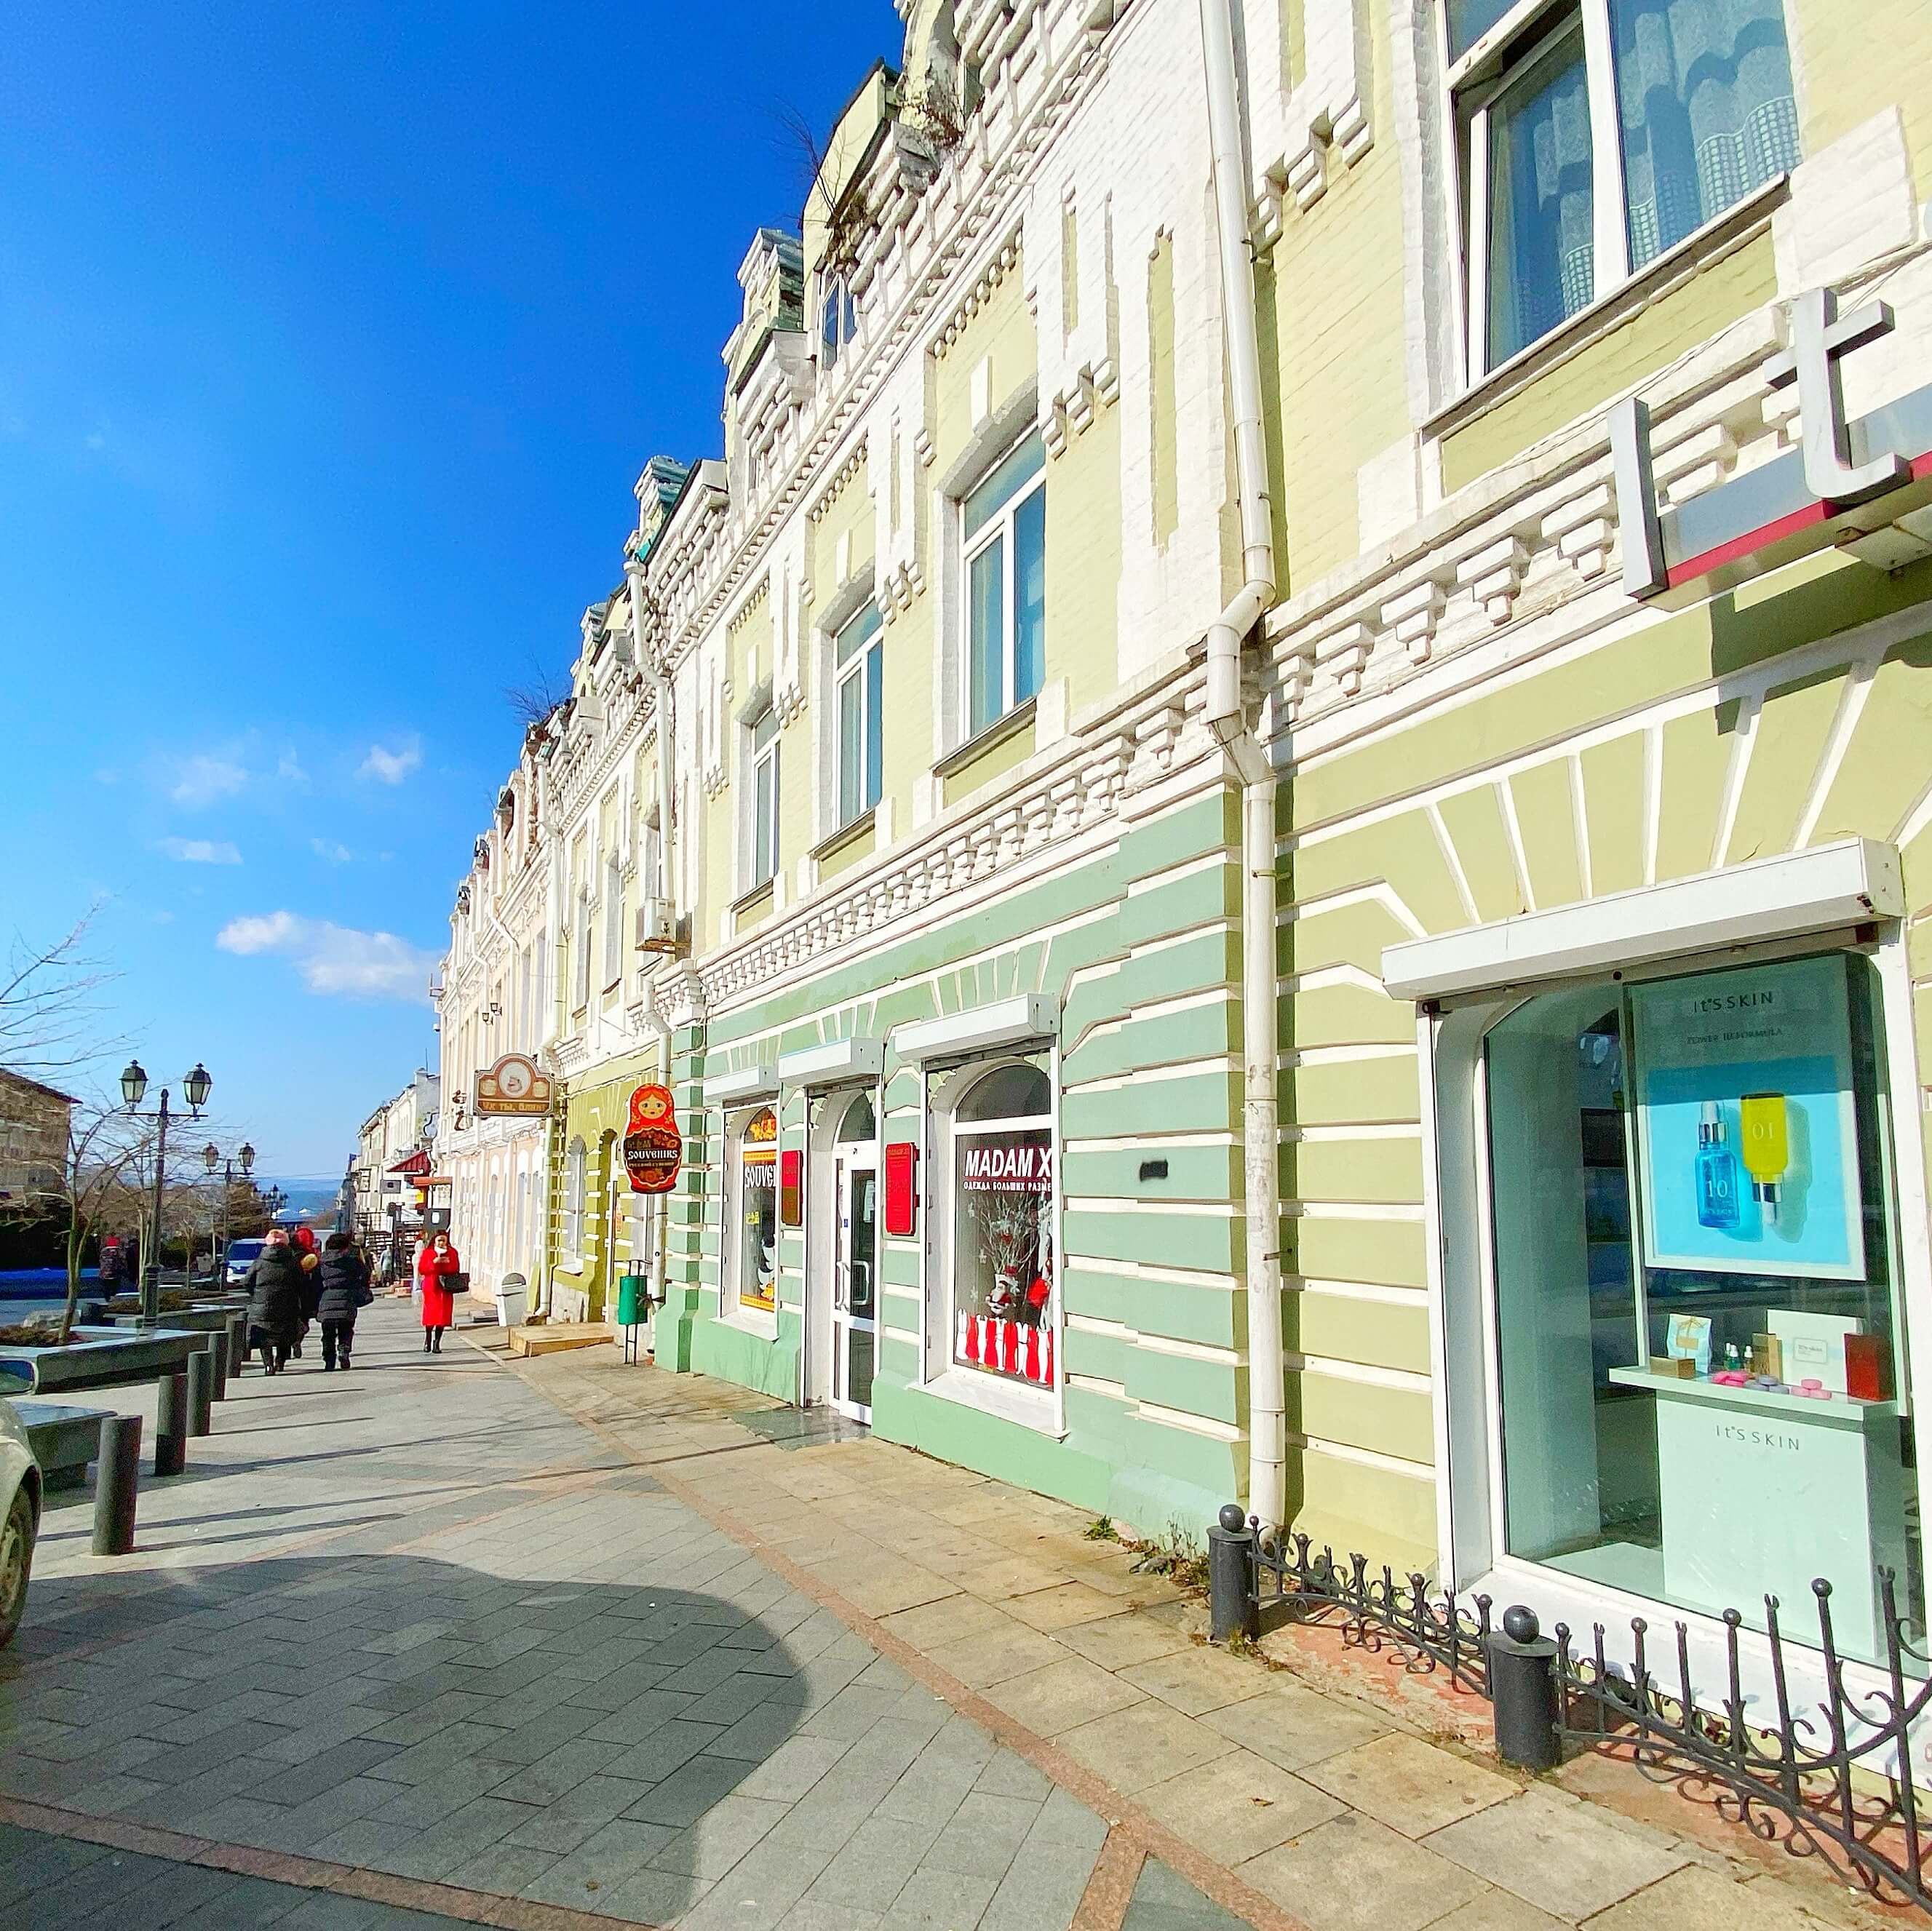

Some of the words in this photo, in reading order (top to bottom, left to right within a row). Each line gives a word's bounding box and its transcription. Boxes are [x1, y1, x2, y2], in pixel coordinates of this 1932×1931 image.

[1727, 991, 1773, 1009] SKIN
[964, 1147, 1034, 1178] MADAM
[1706, 1180, 1728, 1198] 10
[1752, 1431, 1800, 1450] SKIN
